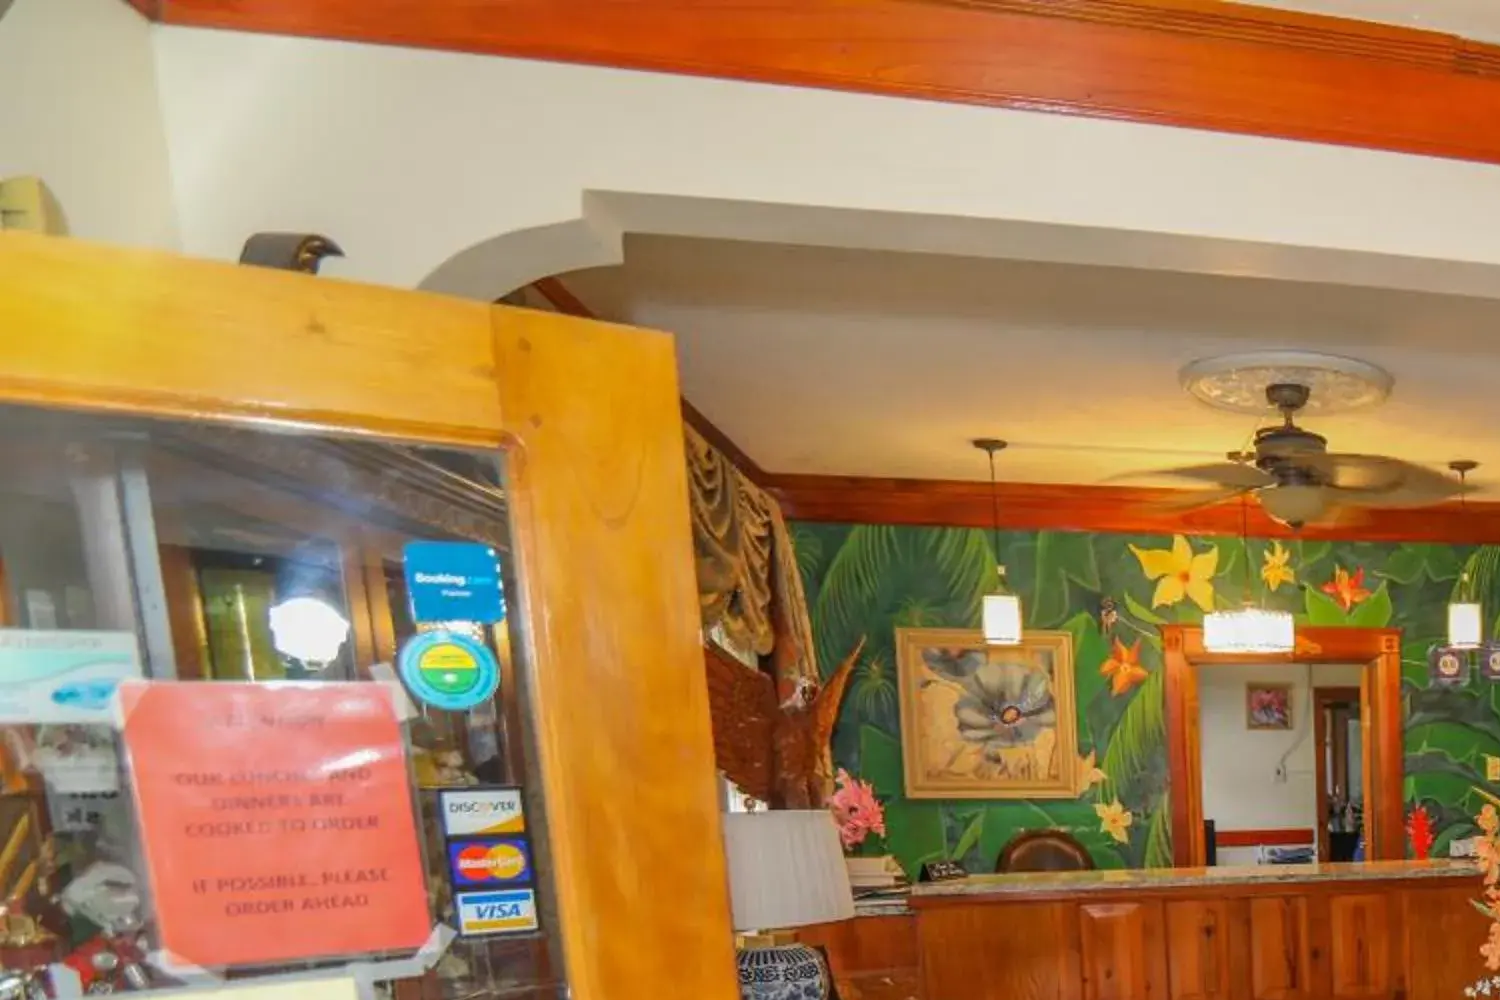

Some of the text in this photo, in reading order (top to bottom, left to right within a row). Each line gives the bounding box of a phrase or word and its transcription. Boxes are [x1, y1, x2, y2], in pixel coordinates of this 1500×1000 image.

[449, 800, 517, 813] DISCOVER
[225, 893, 370, 918] ORDER AHEAD
[474, 903, 522, 919] VISA
